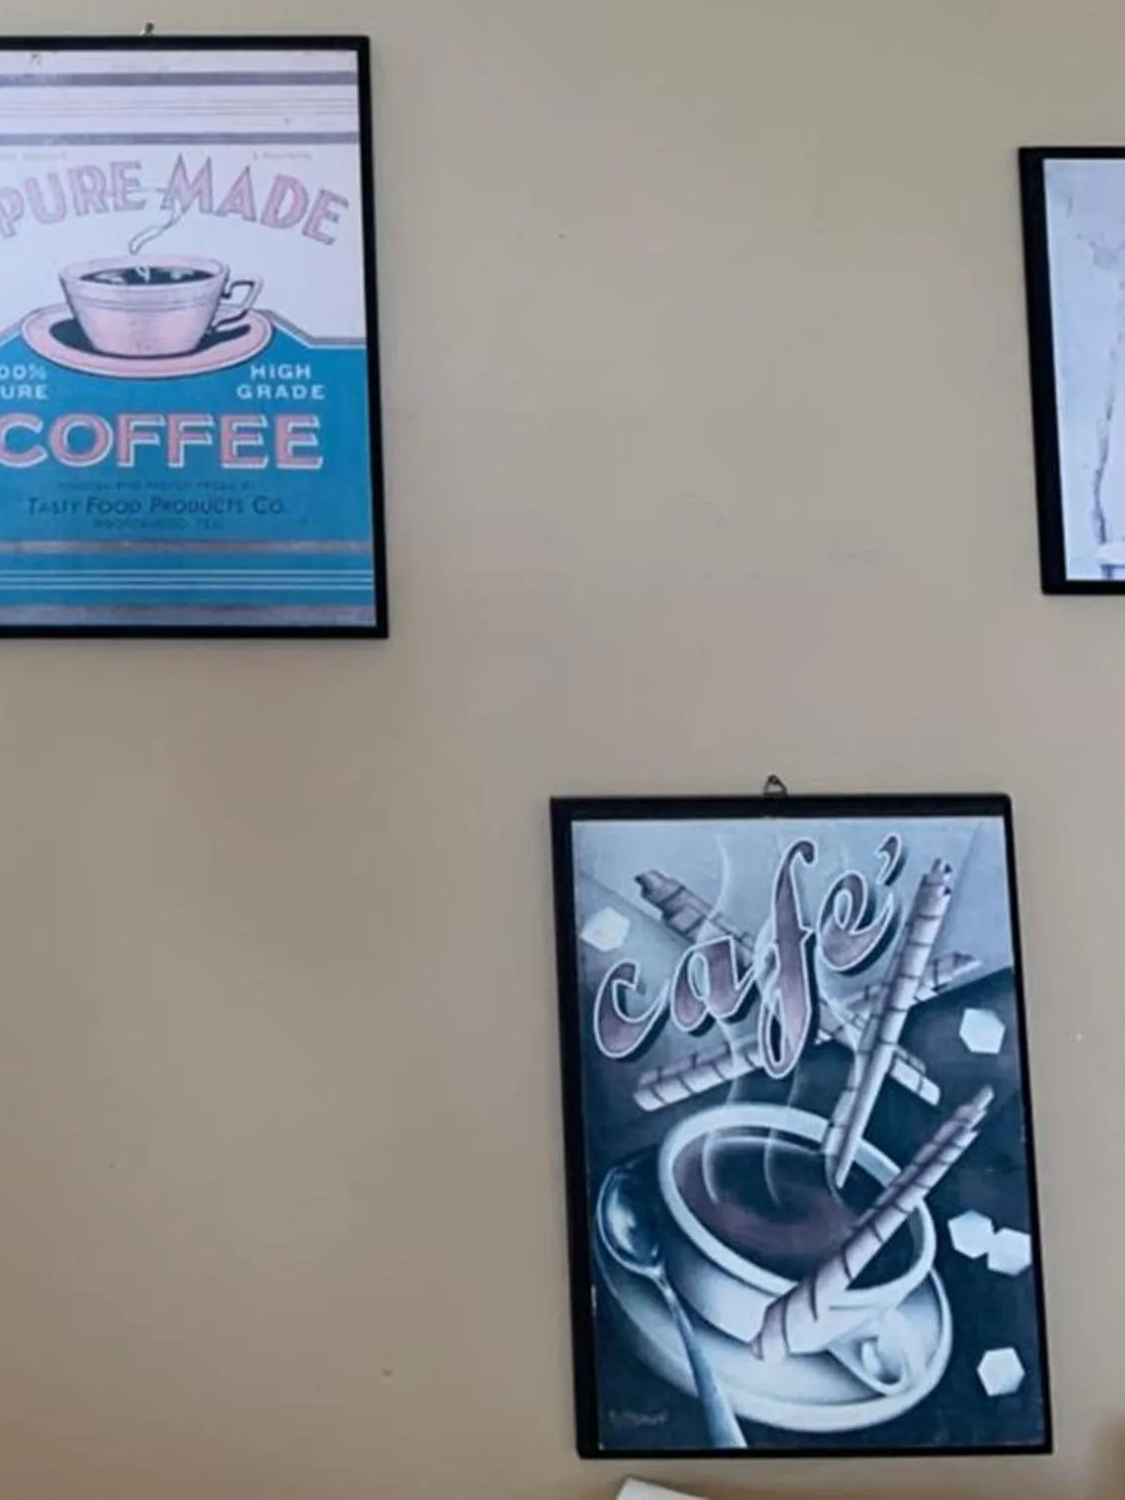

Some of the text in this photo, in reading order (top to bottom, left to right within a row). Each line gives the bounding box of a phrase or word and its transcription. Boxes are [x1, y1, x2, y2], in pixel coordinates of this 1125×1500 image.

[159, 152, 350, 246] MADE
[250, 364, 312, 380] HIGH
[236, 384, 326, 400] GRADE
